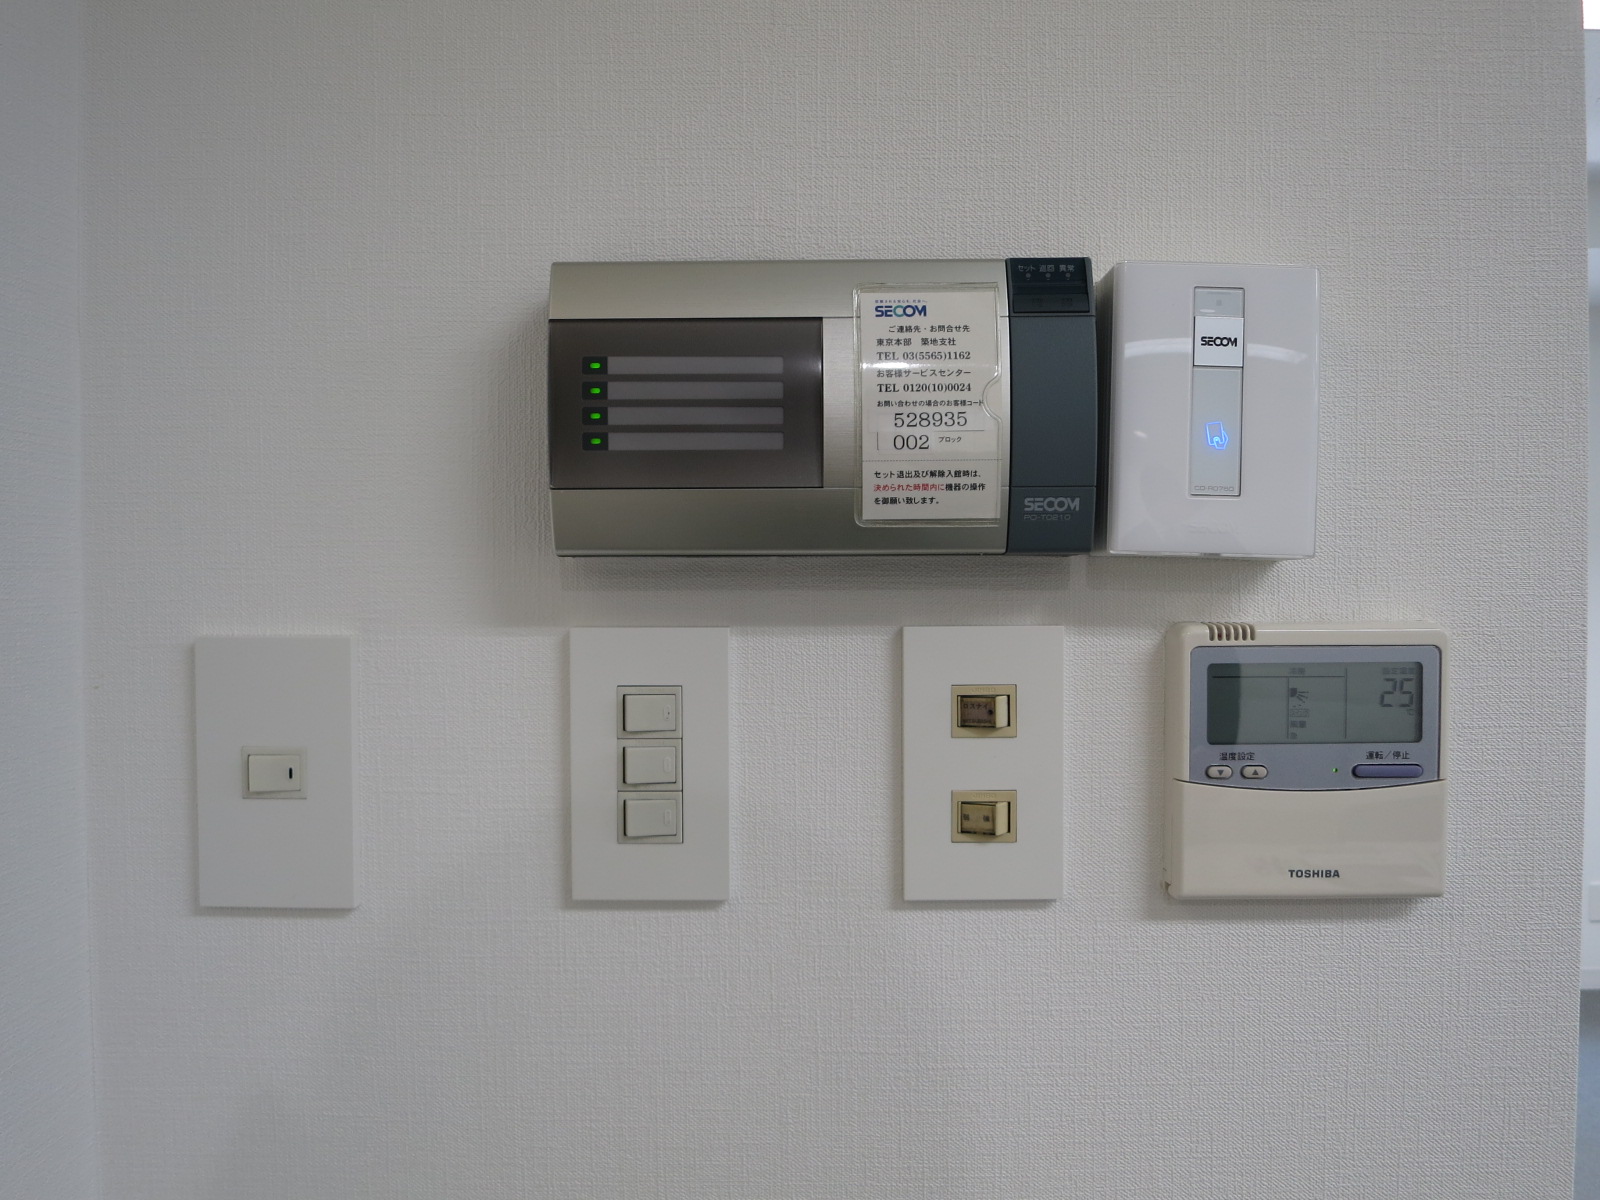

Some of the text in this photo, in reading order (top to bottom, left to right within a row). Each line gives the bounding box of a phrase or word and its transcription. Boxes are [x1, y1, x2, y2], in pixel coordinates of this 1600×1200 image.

[875, 305, 927, 317] SECOM
[889, 325, 970, 333] ご連絡先・お問合せ先
[876, 338, 956, 346] 東京本部 築地支社
[1200, 336, 1238, 347] SECOM
[876, 351, 971, 360] TEL 03(5565)1162
[876, 368, 972, 378] お客様サービスセンター
[876, 383, 972, 393] TEL 0120(10)0024
[894, 412, 968, 428] 528935
[893, 434, 930, 450] 002
[874, 483, 986, 492] 決められた時間内に機器の操作
[1024, 497, 1080, 511] SECOM
[1379, 678, 1414, 708] 25
[1220, 752, 1255, 760] 温度設定
[1288, 870, 1340, 878] TOSHIBA
